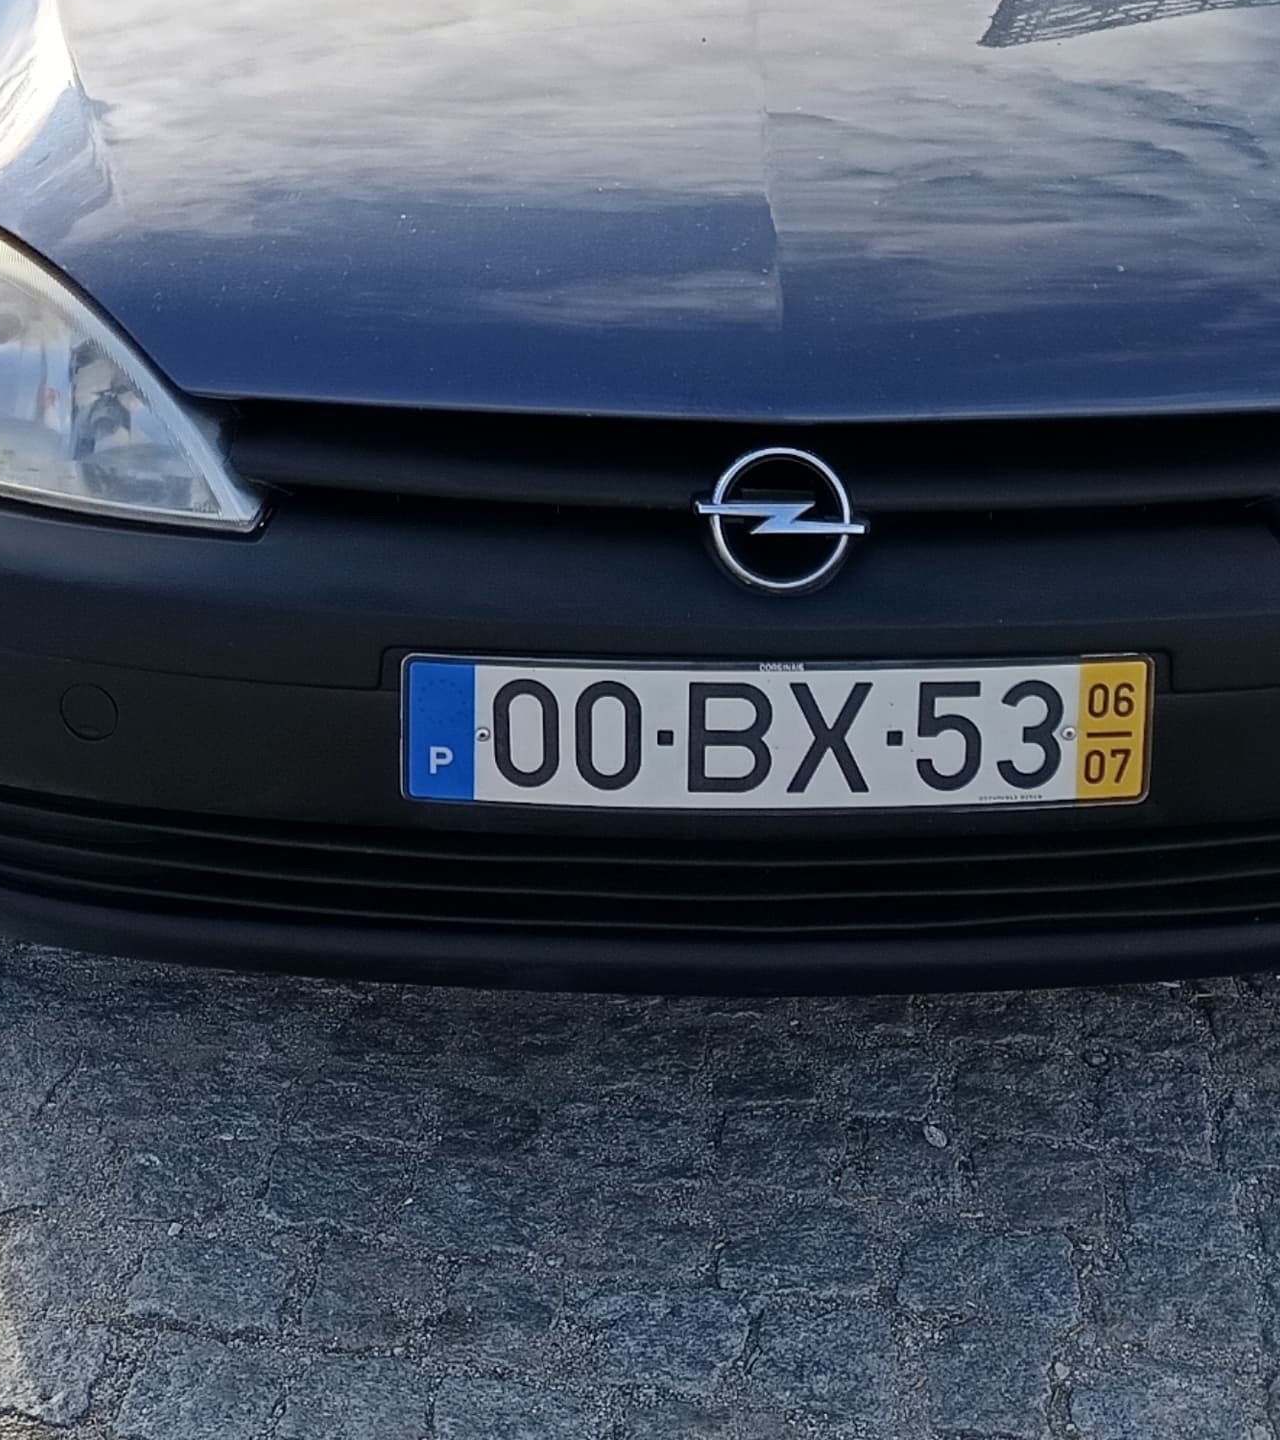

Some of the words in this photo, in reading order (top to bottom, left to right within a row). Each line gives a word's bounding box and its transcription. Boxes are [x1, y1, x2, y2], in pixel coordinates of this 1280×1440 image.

[1087, 682, 1136, 718] 06
[428, 746, 453, 775] P
[1083, 748, 1132, 784] 07
